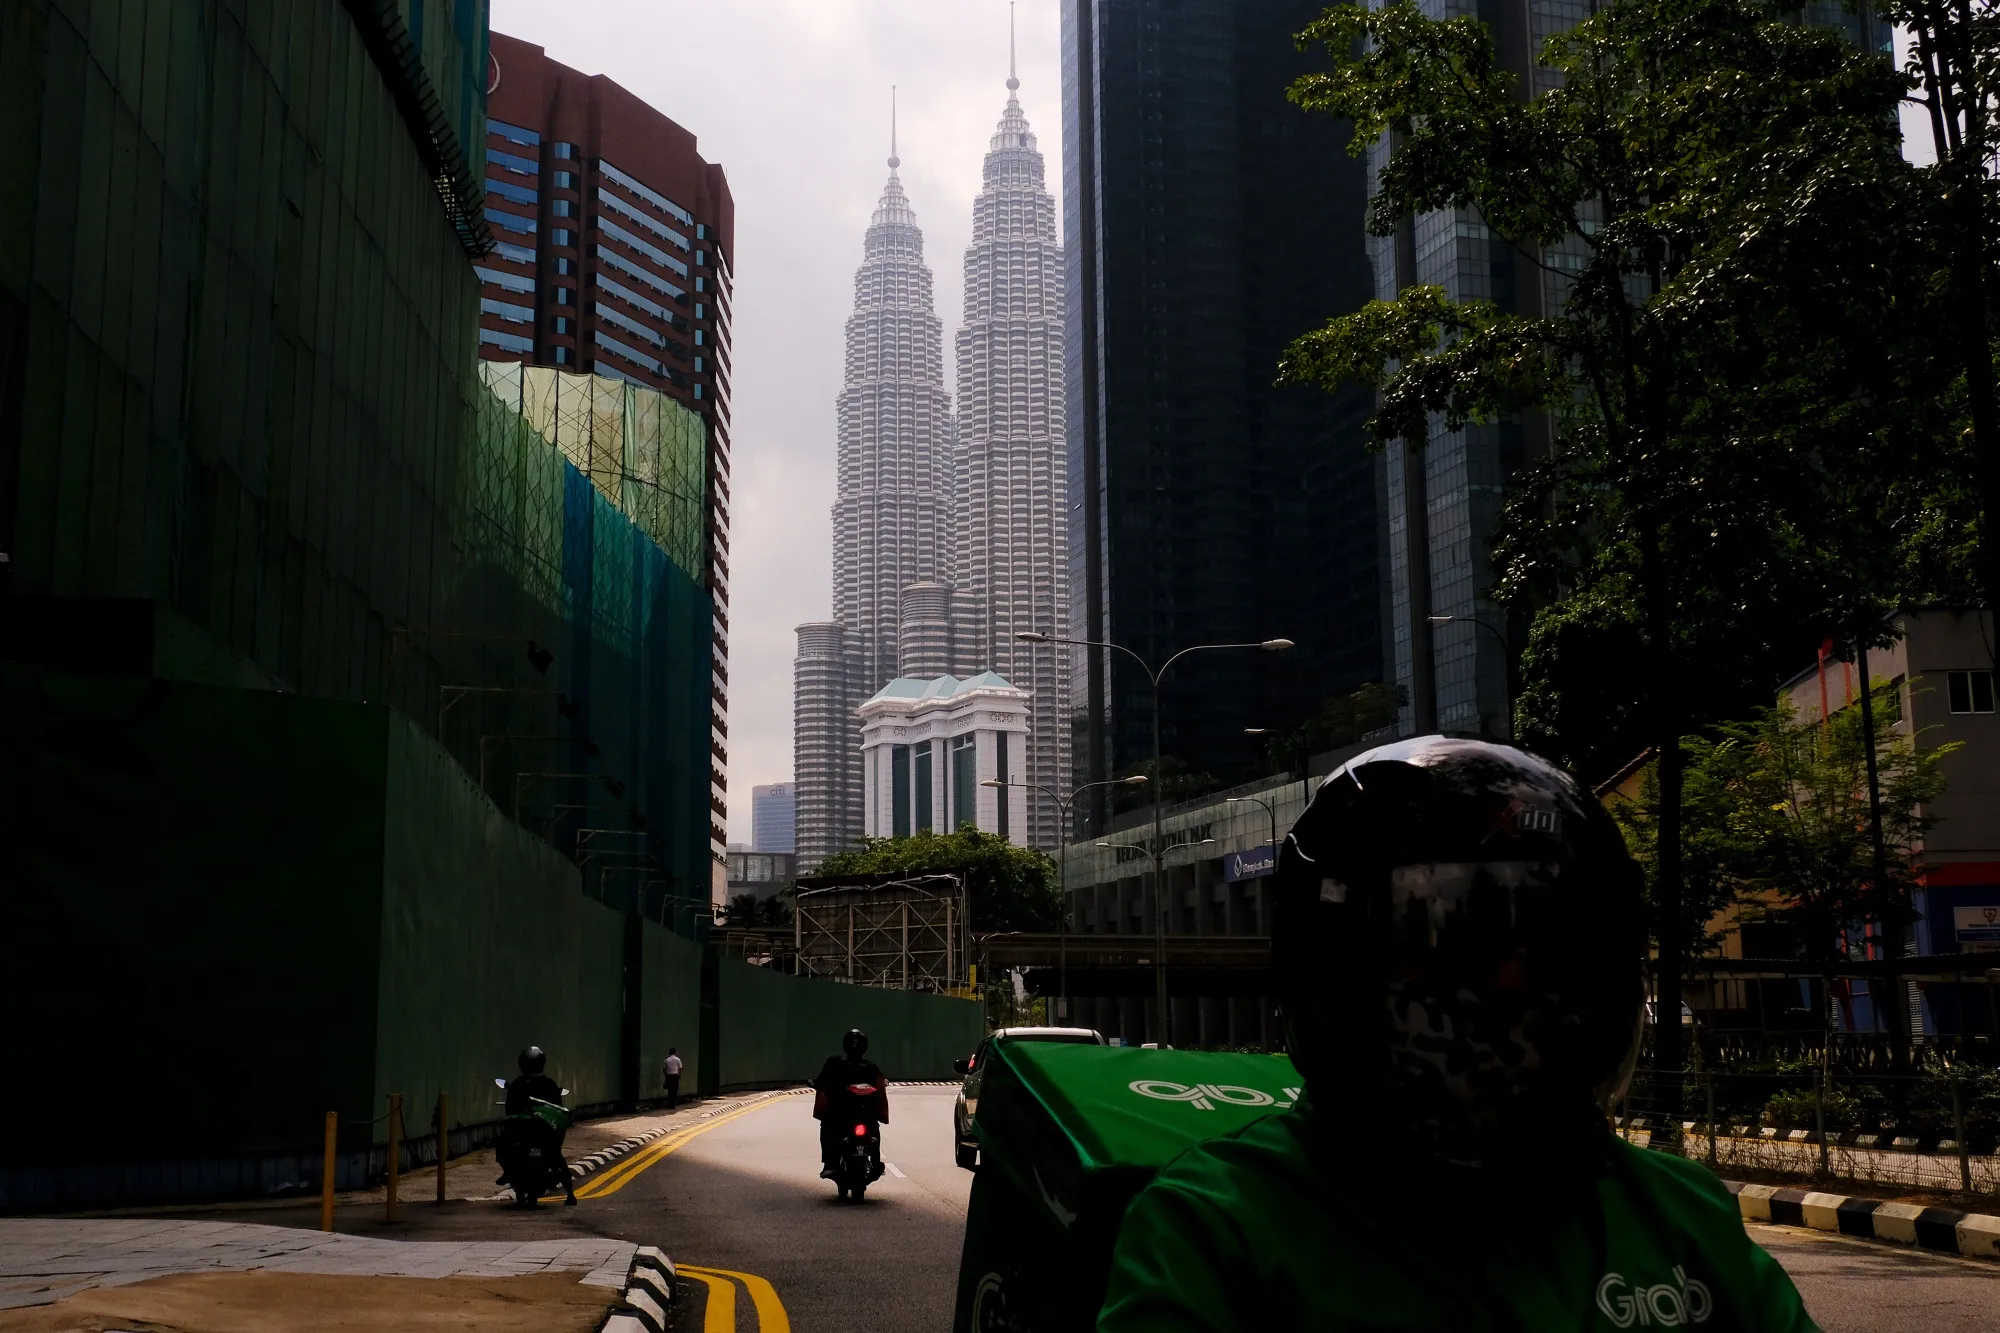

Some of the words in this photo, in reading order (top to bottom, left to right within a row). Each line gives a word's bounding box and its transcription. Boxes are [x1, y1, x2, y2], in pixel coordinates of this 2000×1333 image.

[1150, 829, 1186, 855] CNTRAL
[1191, 822, 1213, 843] PARK
[1243, 861, 1264, 874] Bangkok
[1595, 1264, 1713, 1329] Grab
